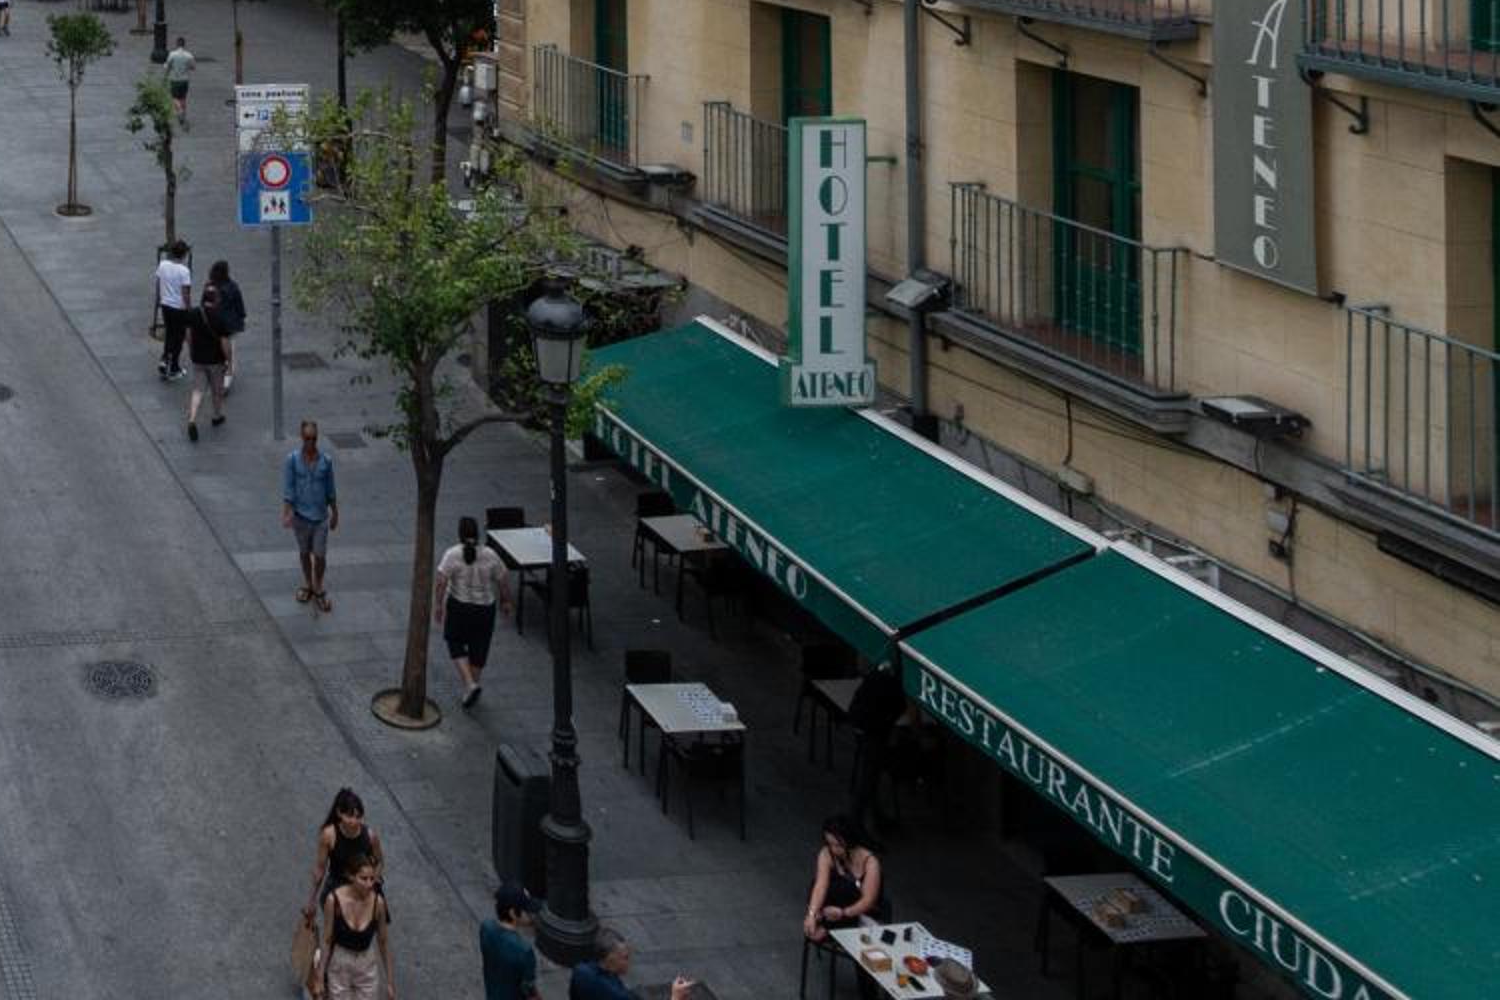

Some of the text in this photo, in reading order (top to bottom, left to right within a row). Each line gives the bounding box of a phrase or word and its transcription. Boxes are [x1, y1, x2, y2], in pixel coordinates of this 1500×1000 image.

[819, 129, 848, 354] HOTEL
[794, 371, 873, 399] ATENEO
[690, 489, 809, 600] ATENEO
[918, 668, 1176, 884] RESTAURANTE
